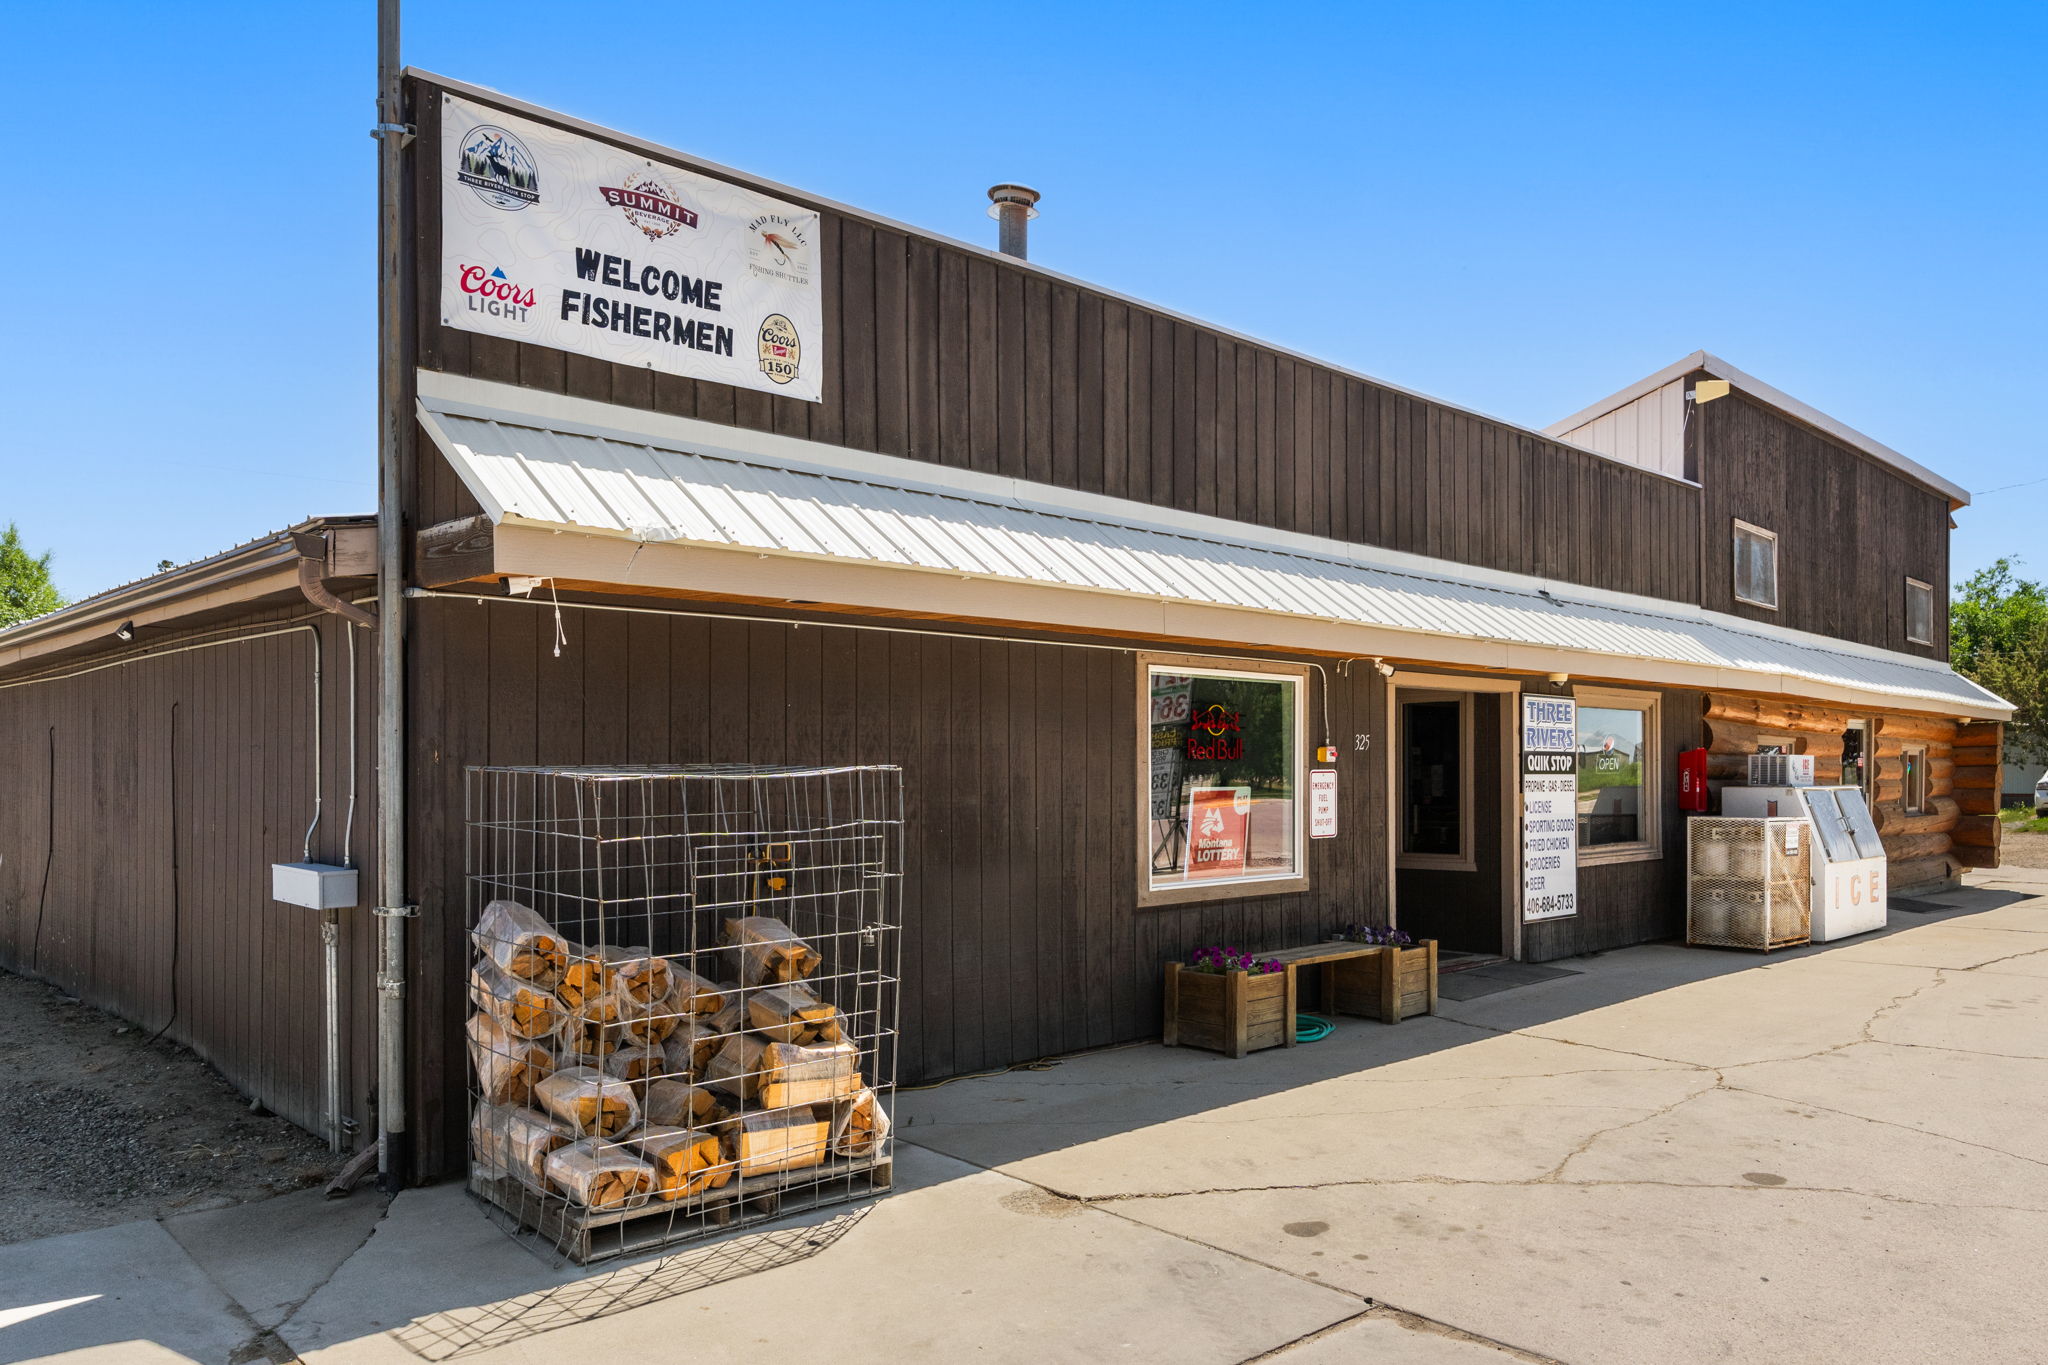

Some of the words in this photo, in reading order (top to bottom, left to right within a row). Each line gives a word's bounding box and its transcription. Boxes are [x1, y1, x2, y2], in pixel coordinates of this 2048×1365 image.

[463, 175, 483, 184] THREE
[484, 180, 504, 191] RIVERS
[505, 187, 519, 196] QUIK
[520, 191, 535, 200] STOP
[608, 190, 694, 223] SUMMIT
[635, 210, 670, 224] BEVERAGE
[749, 215, 767, 233] MAD
[770, 214, 790, 227] FLY
[791, 226, 807, 247] LLC
[749, 263, 774, 277] FISHING
[459, 263, 537, 308] Coors
[575, 246, 723, 312] WELCOME
[468, 295, 528, 323] LIGHT
[561, 289, 734, 357] FISHERMEN
[761, 327, 797, 348] Coors
[768, 361, 792, 375] 150
[1527, 701, 1573, 724] THREE
[1354, 734, 1370, 751] 325
[1526, 727, 1574, 750] RIVERS
[1187, 737, 1215, 760] Red
[1217, 737, 1243, 760] Bull
[1527, 755, 1550, 772] QUIK
[1551, 755, 1573, 772] STOP
[1599, 757, 1619, 770] OPEN
[1312, 781, 1334, 791] EMERGENCY
[1525, 780, 1546, 792] PROPANE
[1548, 780, 1558, 792] GAS
[1560, 780, 1575, 792] DIESEL
[1318, 793, 1329, 802] FUEL
[1318, 806, 1329, 815] PUMP
[1529, 800, 1552, 814] LICENSE
[1314, 817, 1333, 827] SHUT-OFF
[1529, 820, 1555, 833] SPORTING
[1556, 818, 1574, 831] GOODS
[1198, 838, 1233, 849] Montana
[1529, 839, 1546, 852] FRIED
[1546, 837, 1570, 851] CHICKEN
[1197, 847, 1240, 863] LOTTERY
[1529, 855, 1561, 871] GROCERIES
[1529, 876, 1545, 891] BEER
[1834, 871, 1880, 910] ICE
[1526, 893, 1574, 915] 406-684-5733
